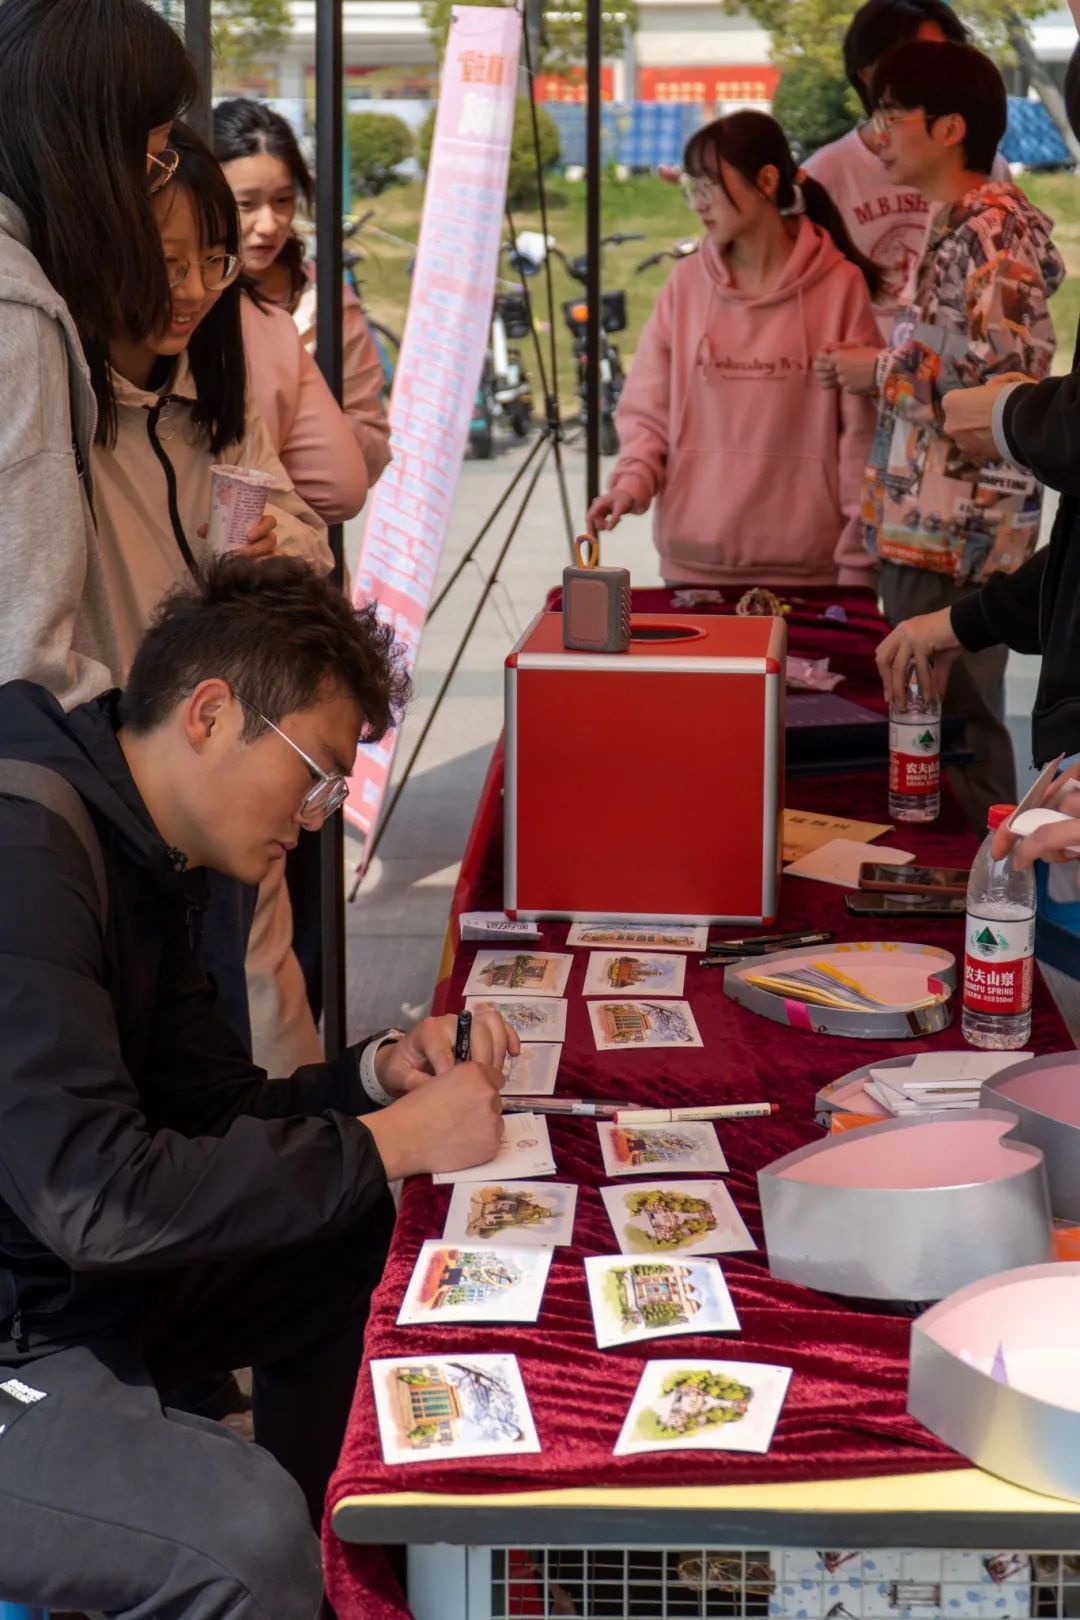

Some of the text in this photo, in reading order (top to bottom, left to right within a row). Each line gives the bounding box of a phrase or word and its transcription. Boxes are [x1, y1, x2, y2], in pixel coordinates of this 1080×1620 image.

[965, 965, 1015, 987] 农夫山泉
[987, 986, 1014, 996] SPRING
